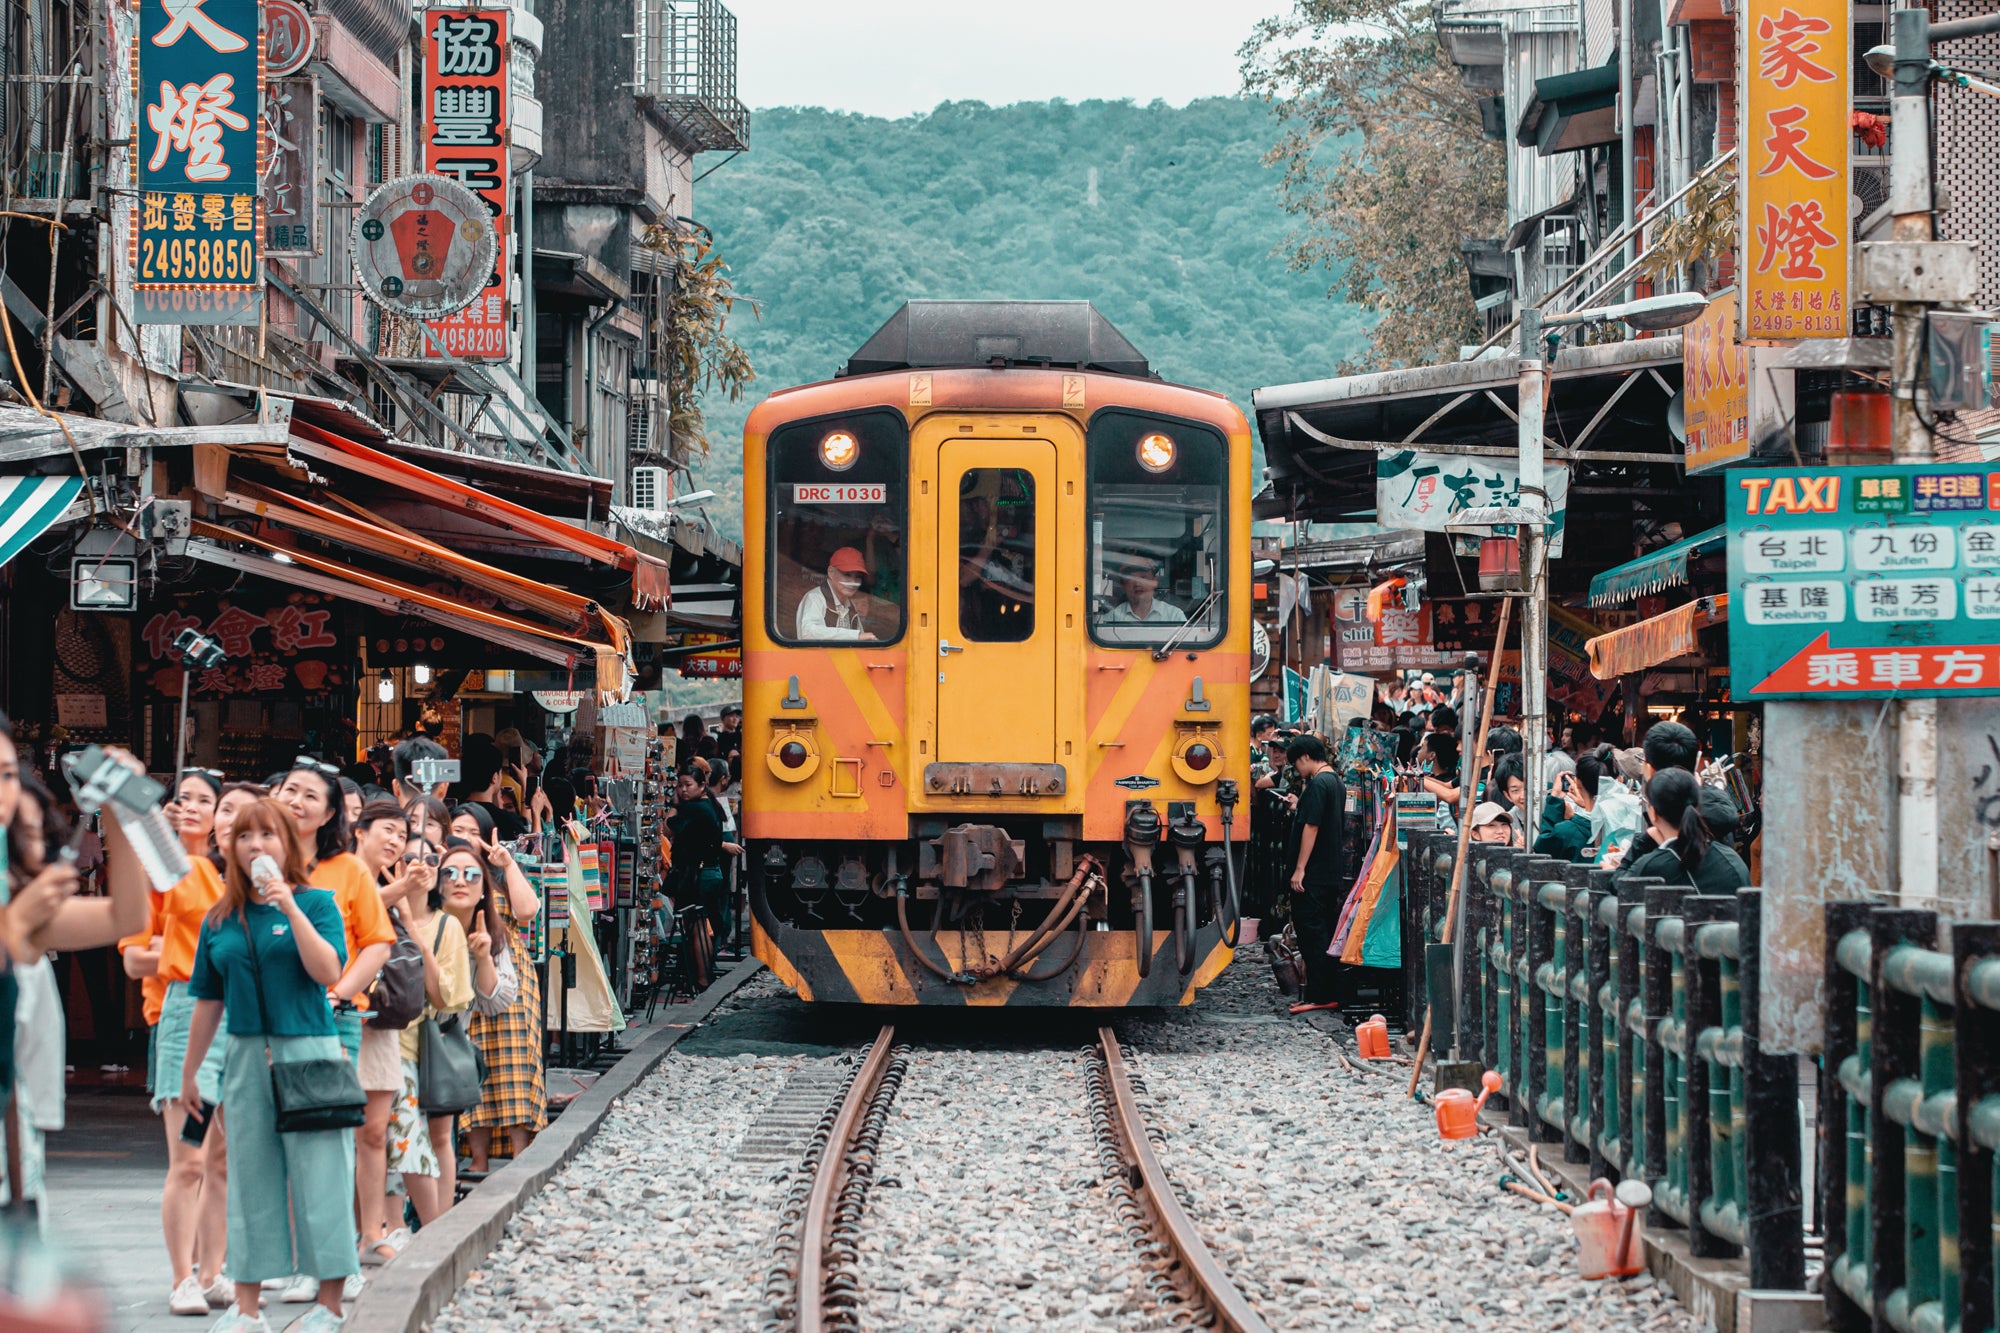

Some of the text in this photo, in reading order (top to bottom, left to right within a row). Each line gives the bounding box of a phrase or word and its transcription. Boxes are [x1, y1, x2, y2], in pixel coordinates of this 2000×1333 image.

[1755, 7, 1839, 282] 家天燈
[143, 191, 253, 232] 批發零售
[142, 238, 253, 279] 24958850
[1753, 289, 1841, 312] 天燈創始店
[1752, 314, 1841, 331] 2495-8131
[799, 488, 881, 500] DRC 1030
[1741, 476, 1841, 514] TAXI
[1759, 537, 1828, 557] 台北
[1869, 533, 1938, 554] 九份
[1770, 558, 1817, 570] Taipei
[1880, 555, 1929, 566] Jiufen
[1760, 587, 1829, 608] 基隆
[1871, 584, 1940, 605] 瑞芳
[1763, 609, 1828, 622] Keelung
[1873, 605, 1939, 619] Rui fang
[197, 663, 287, 692] 天燈
